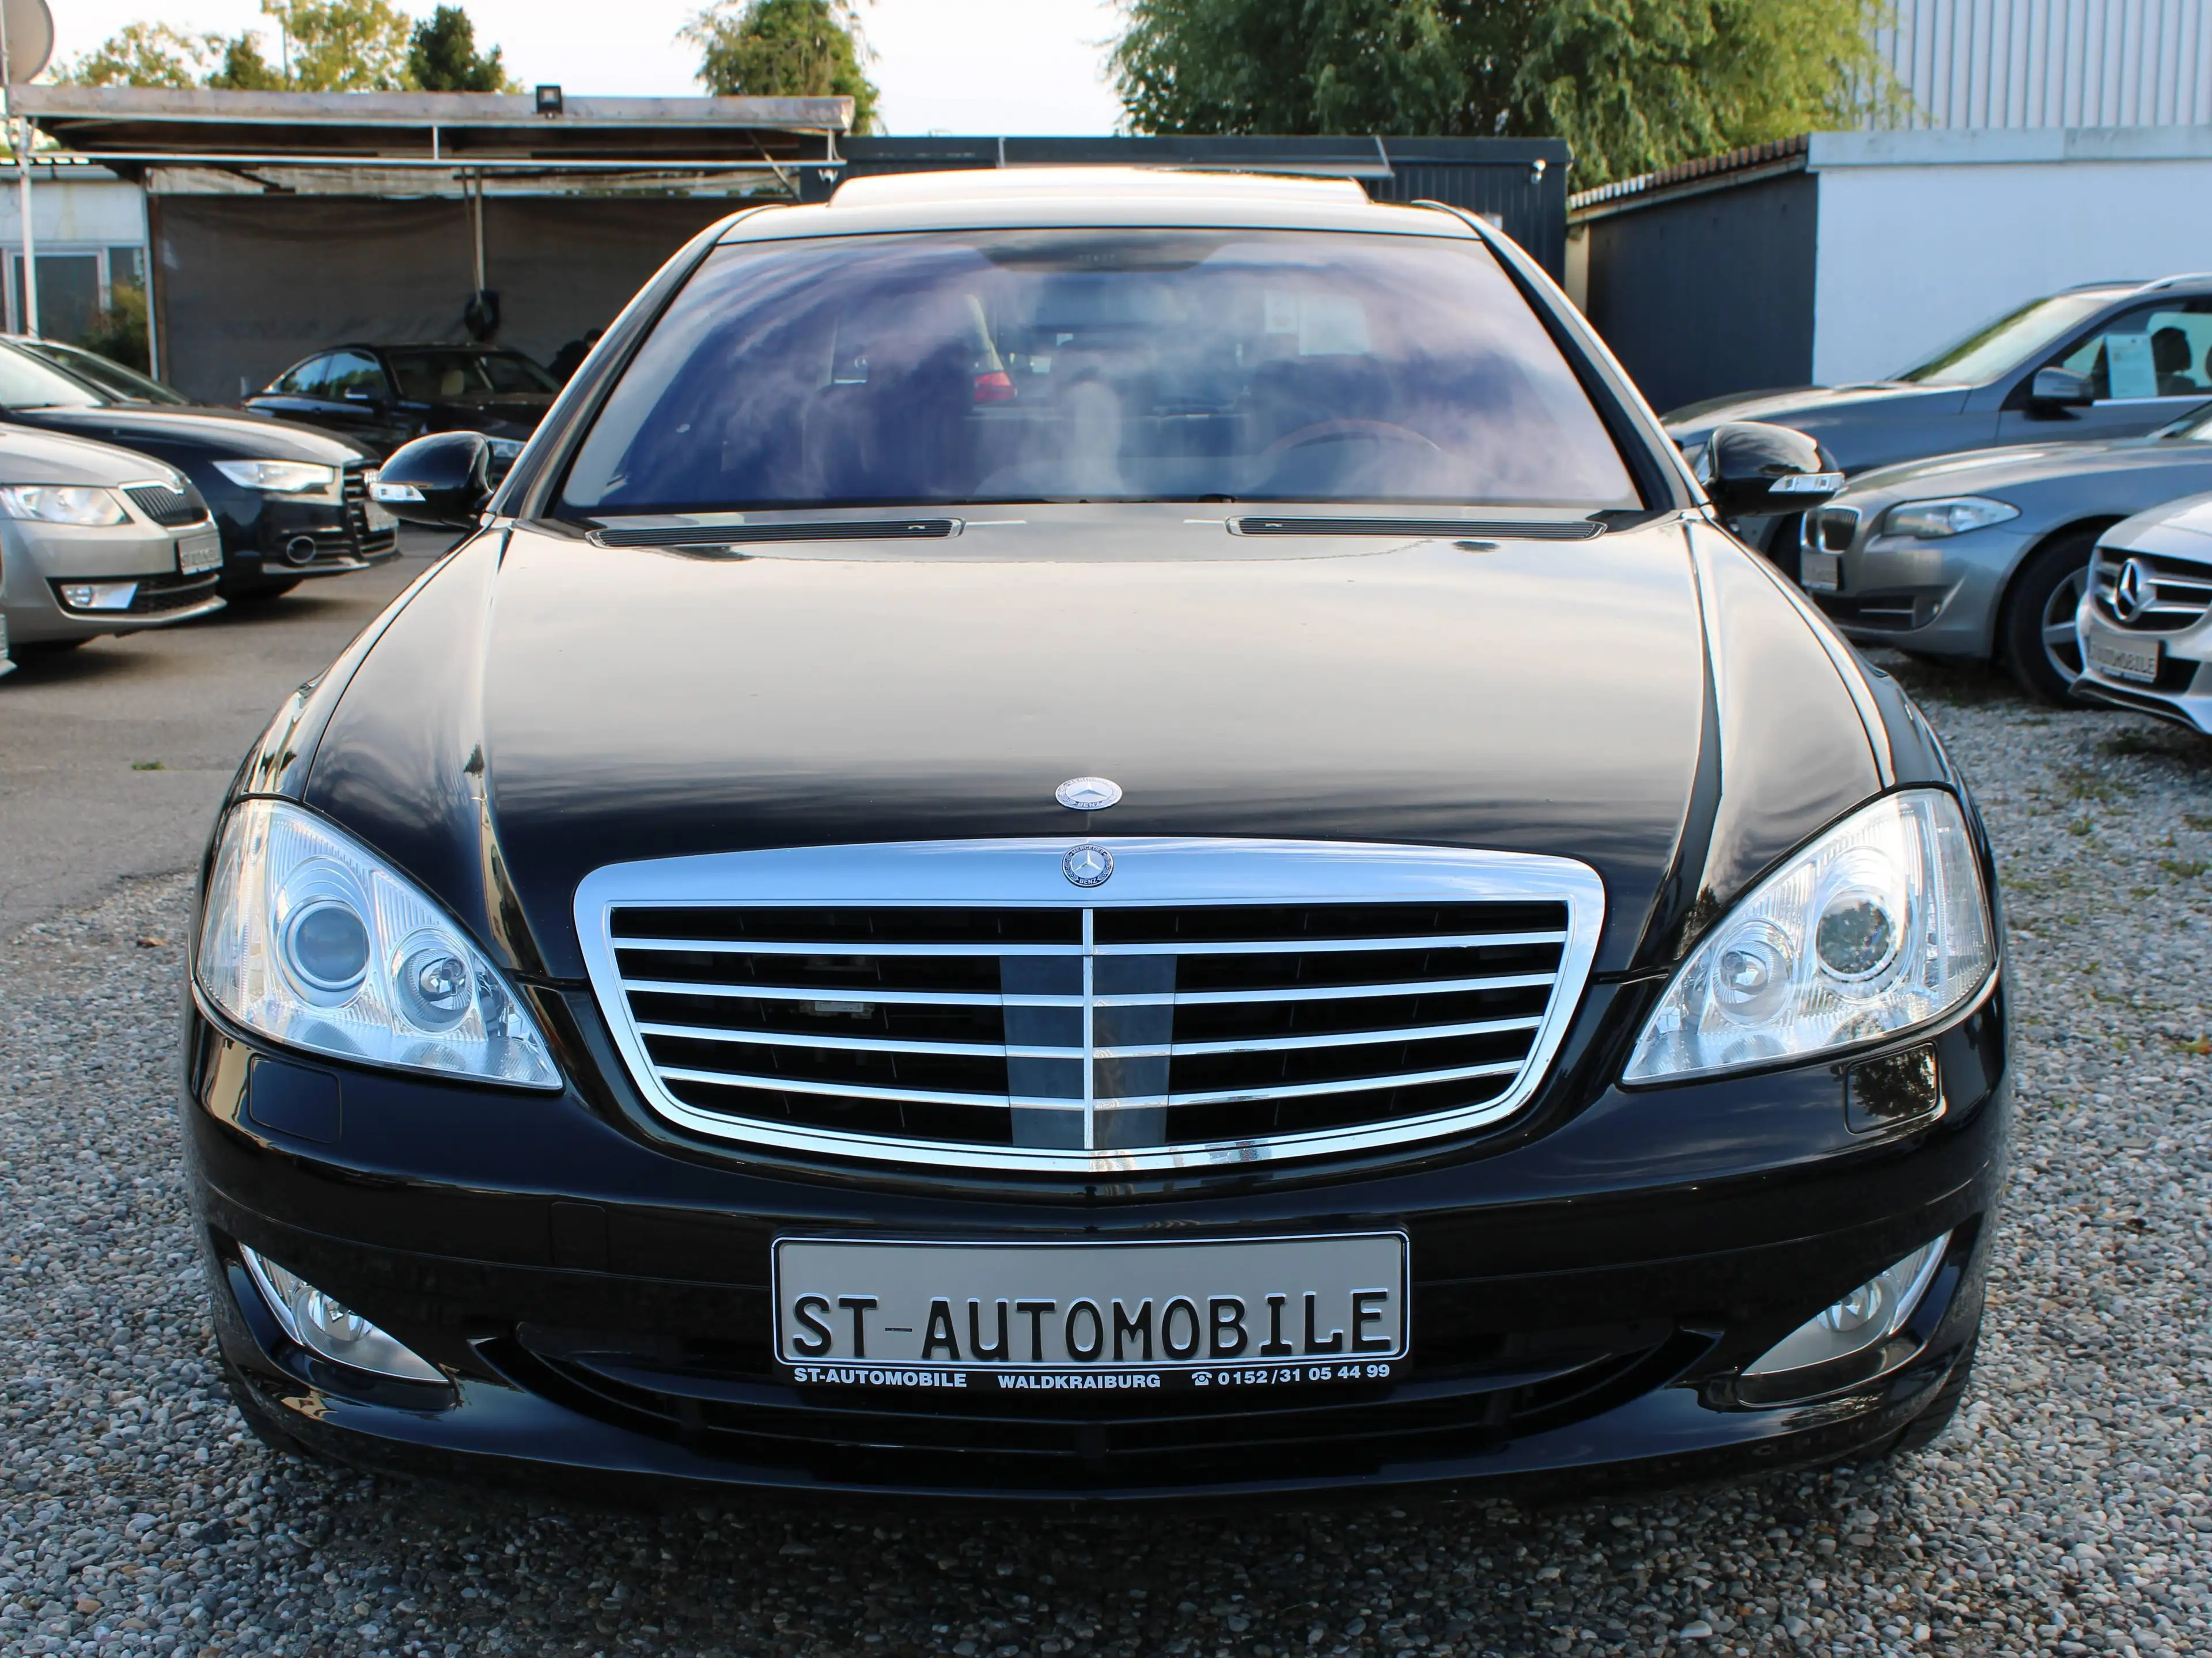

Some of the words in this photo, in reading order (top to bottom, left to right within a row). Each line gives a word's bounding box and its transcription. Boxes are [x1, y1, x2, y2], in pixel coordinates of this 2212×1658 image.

[792, 1288, 1391, 1361] ST-AUTOMOBILE
[794, 1367, 967, 1387] ST-AUTOMOBILE
[998, 1375, 1161, 1388] WALDKRAIBURG
[1308, 1367, 1332, 1380] 05
[1337, 1365, 1361, 1379] 44
[1366, 1364, 1390, 1378] 99
